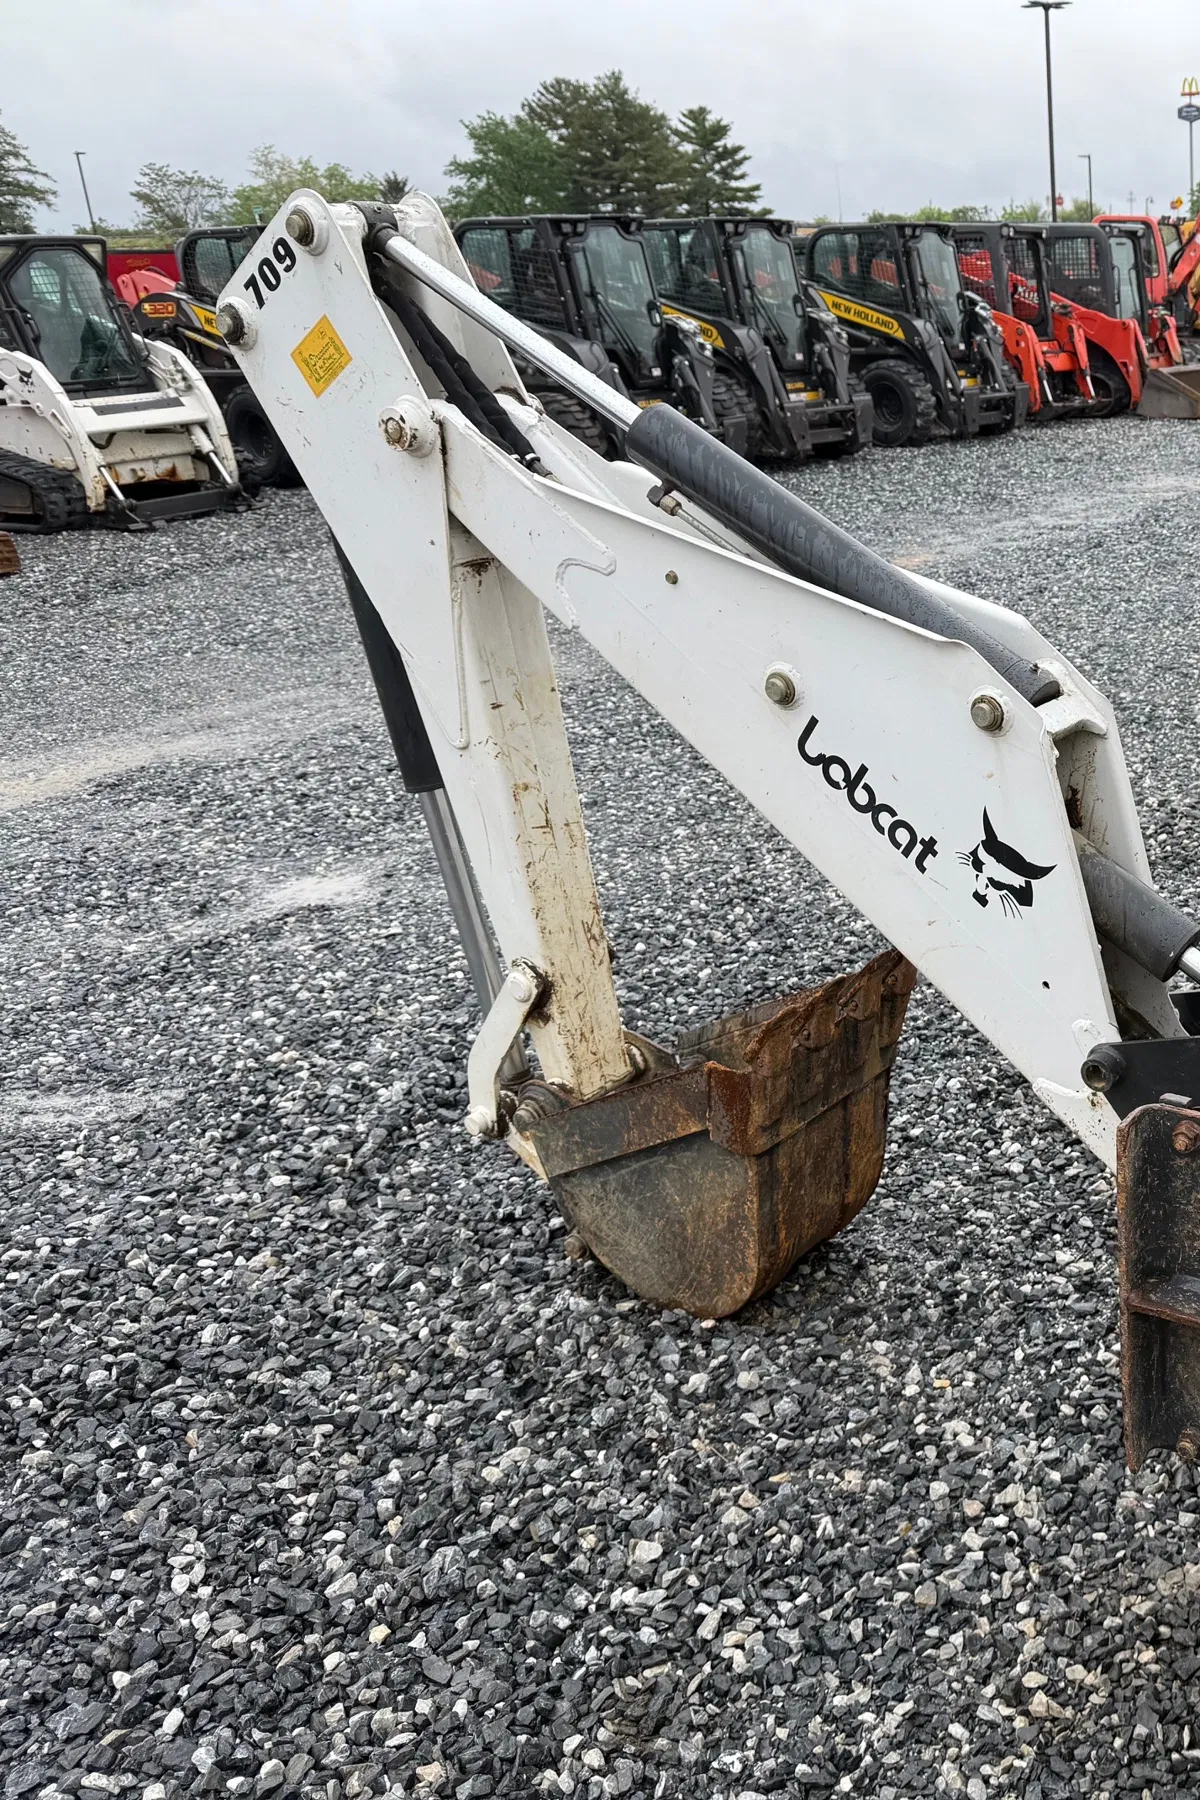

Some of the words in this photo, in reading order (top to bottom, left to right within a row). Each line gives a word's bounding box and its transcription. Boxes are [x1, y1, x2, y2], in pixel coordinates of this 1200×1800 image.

[243, 237, 297, 310] 709
[831, 300, 853, 316] NEW
[853, 308, 895, 331] HOLLAND
